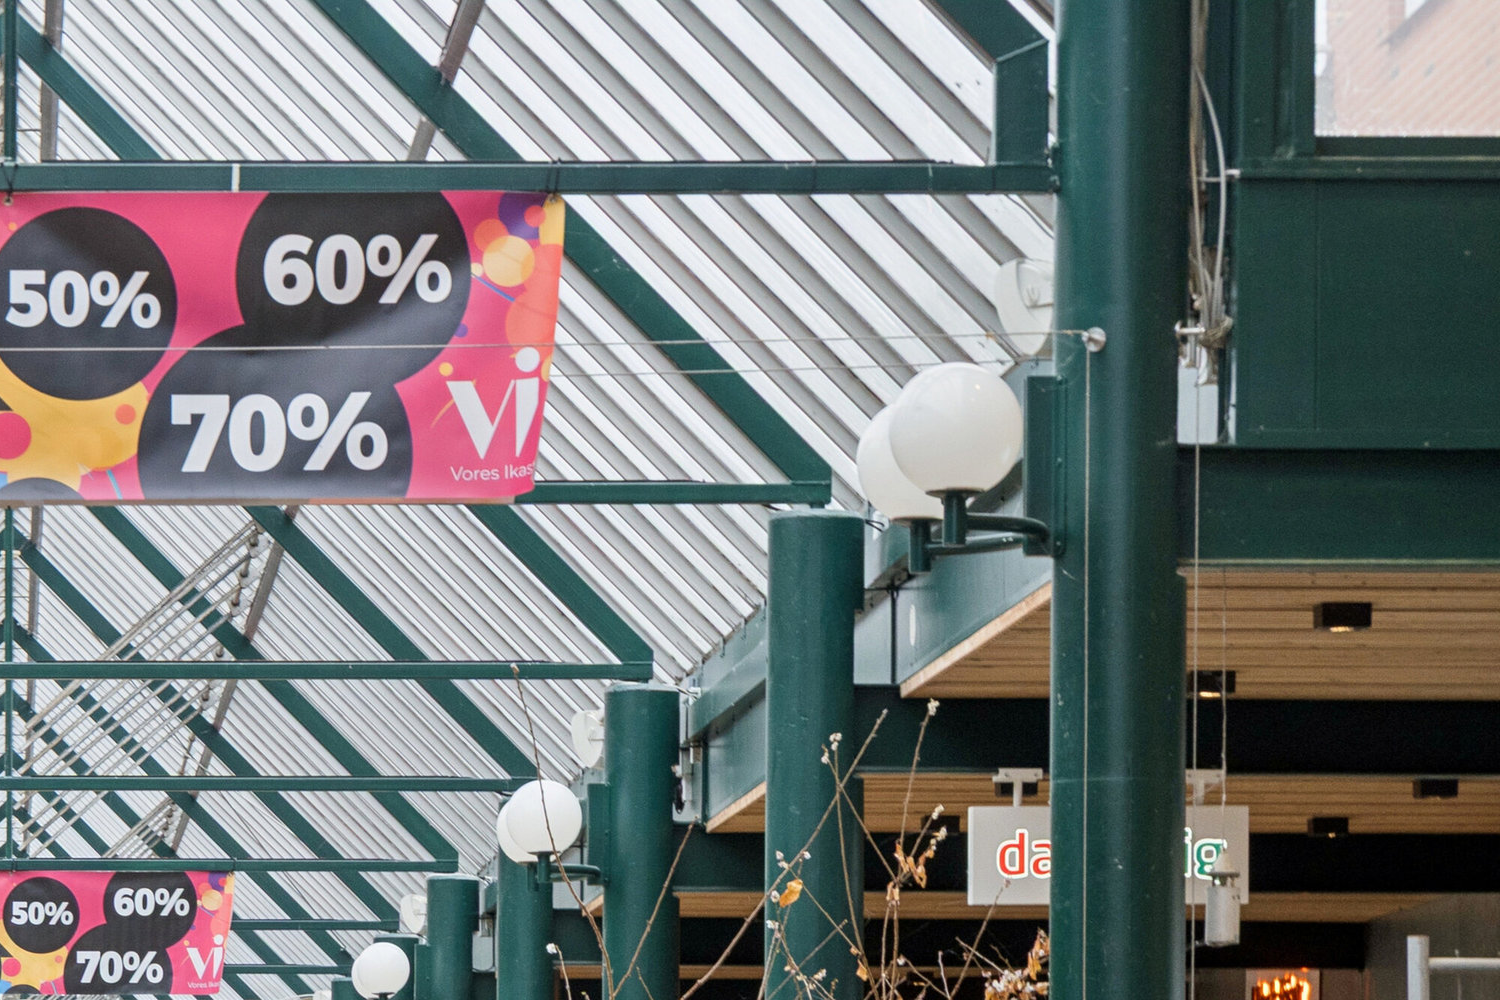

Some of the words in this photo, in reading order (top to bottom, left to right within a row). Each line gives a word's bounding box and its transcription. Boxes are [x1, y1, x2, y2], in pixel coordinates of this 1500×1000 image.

[263, 232, 453, 306] 60%
[5, 269, 161, 329] 50%
[171, 391, 389, 473] 70%
[450, 465, 500, 481] Vores
[10, 901, 74, 925] 50%
[113, 888, 190, 916] 60%
[76, 951, 164, 984] 70%
